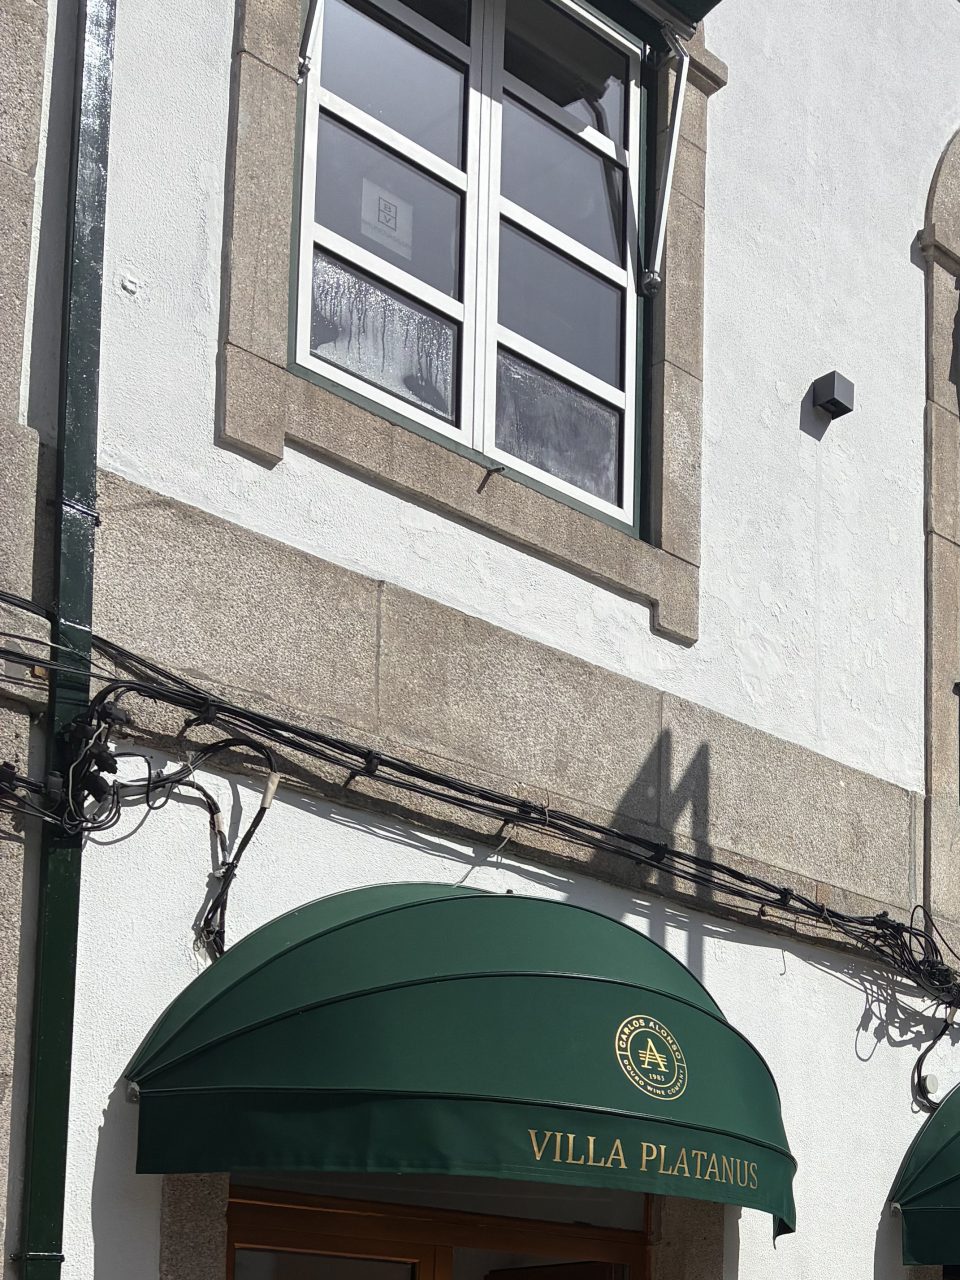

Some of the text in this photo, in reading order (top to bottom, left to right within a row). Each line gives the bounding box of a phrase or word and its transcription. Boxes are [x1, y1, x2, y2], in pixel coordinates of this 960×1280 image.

[619, 1018, 681, 1059] CARLOS ALONSO
[527, 1129, 758, 1189] VILLA PLATANUS
